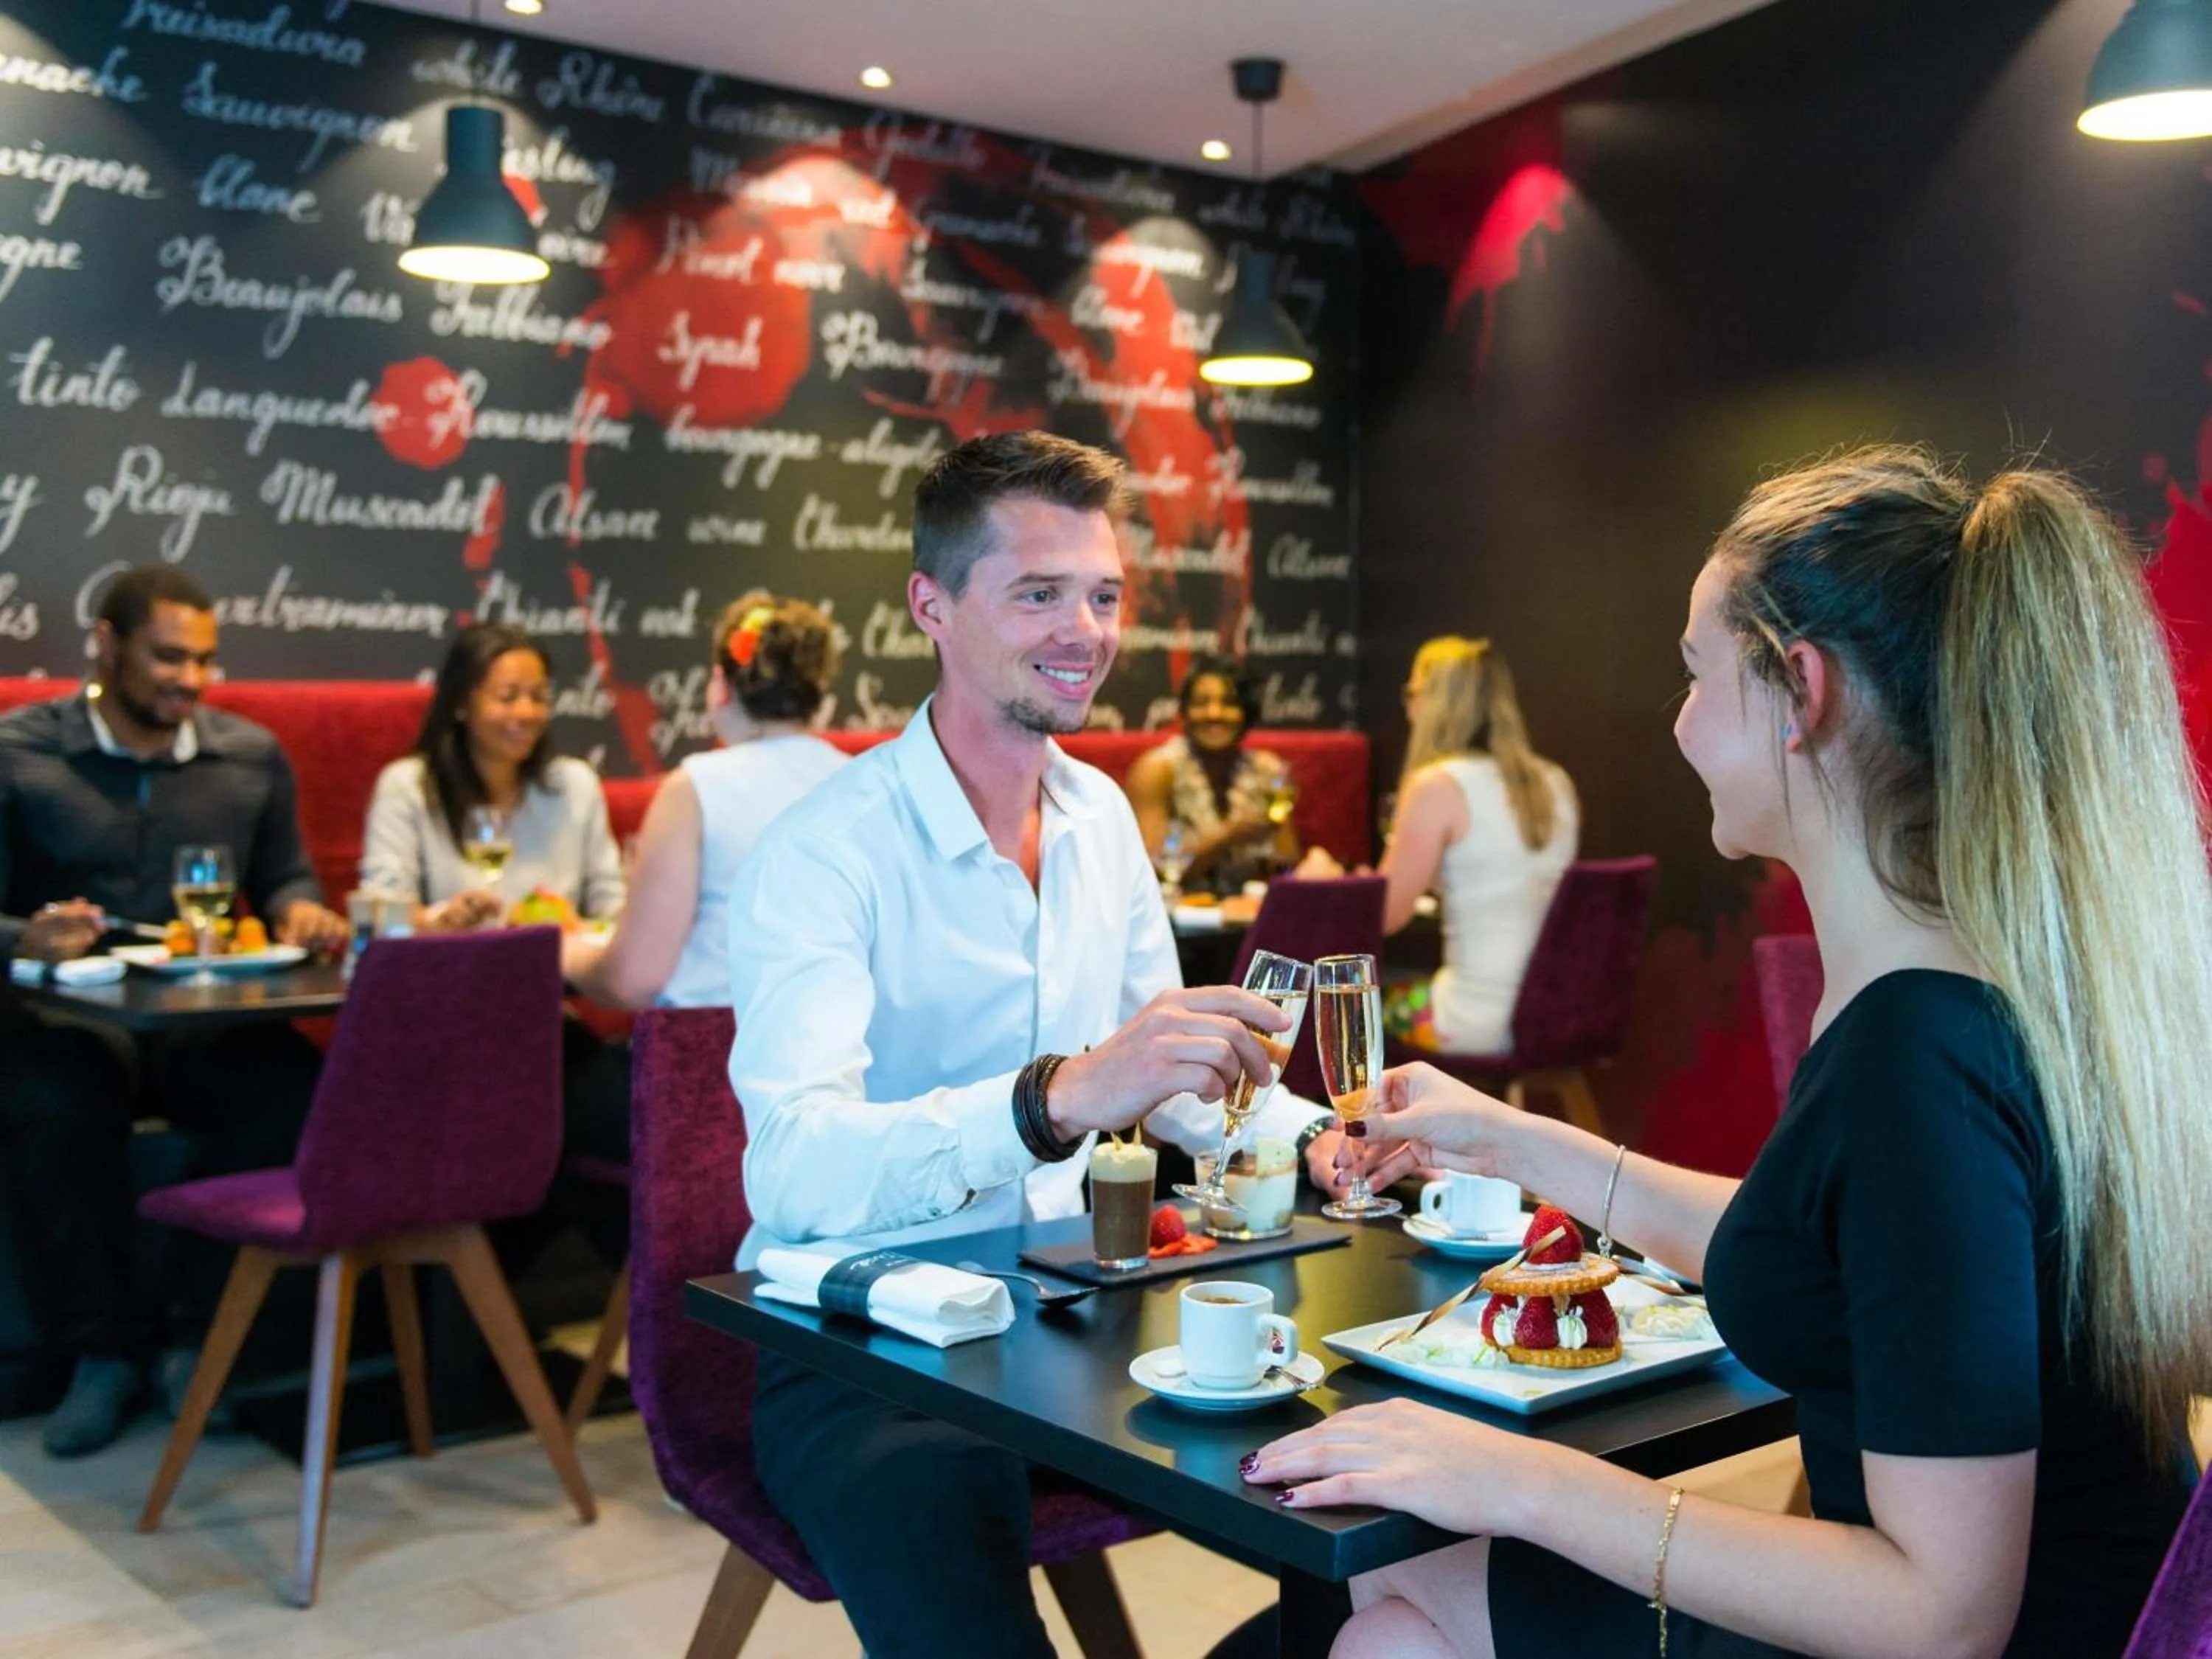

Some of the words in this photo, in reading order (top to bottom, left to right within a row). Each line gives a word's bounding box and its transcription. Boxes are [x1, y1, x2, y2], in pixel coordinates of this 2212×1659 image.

[155, 234, 404, 358] Beaujolais
[9, 336, 140, 411] tinto
[83, 442, 234, 565] Rioja
[528, 482, 661, 541] Alsace
